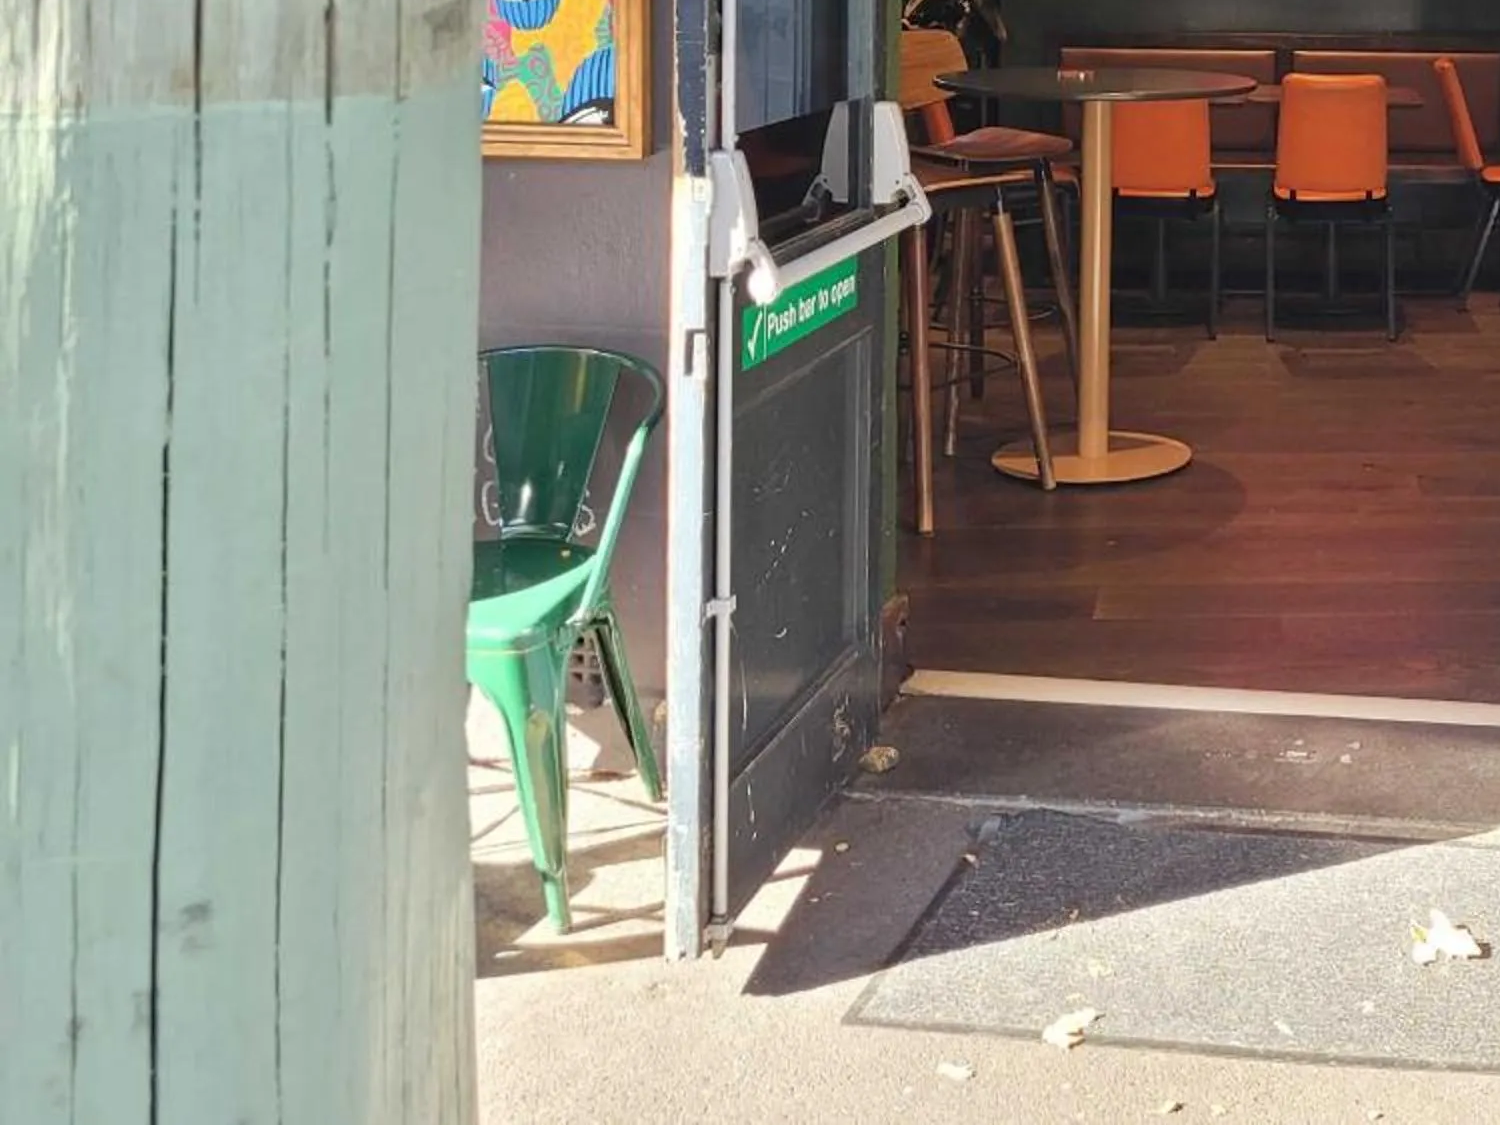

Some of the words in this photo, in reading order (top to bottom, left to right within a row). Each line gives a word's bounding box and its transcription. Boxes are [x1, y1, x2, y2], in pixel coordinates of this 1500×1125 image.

[767, 302, 797, 340] Push
[798, 296, 816, 323] bar
[818, 287, 829, 312] to
[830, 275, 856, 307] open
